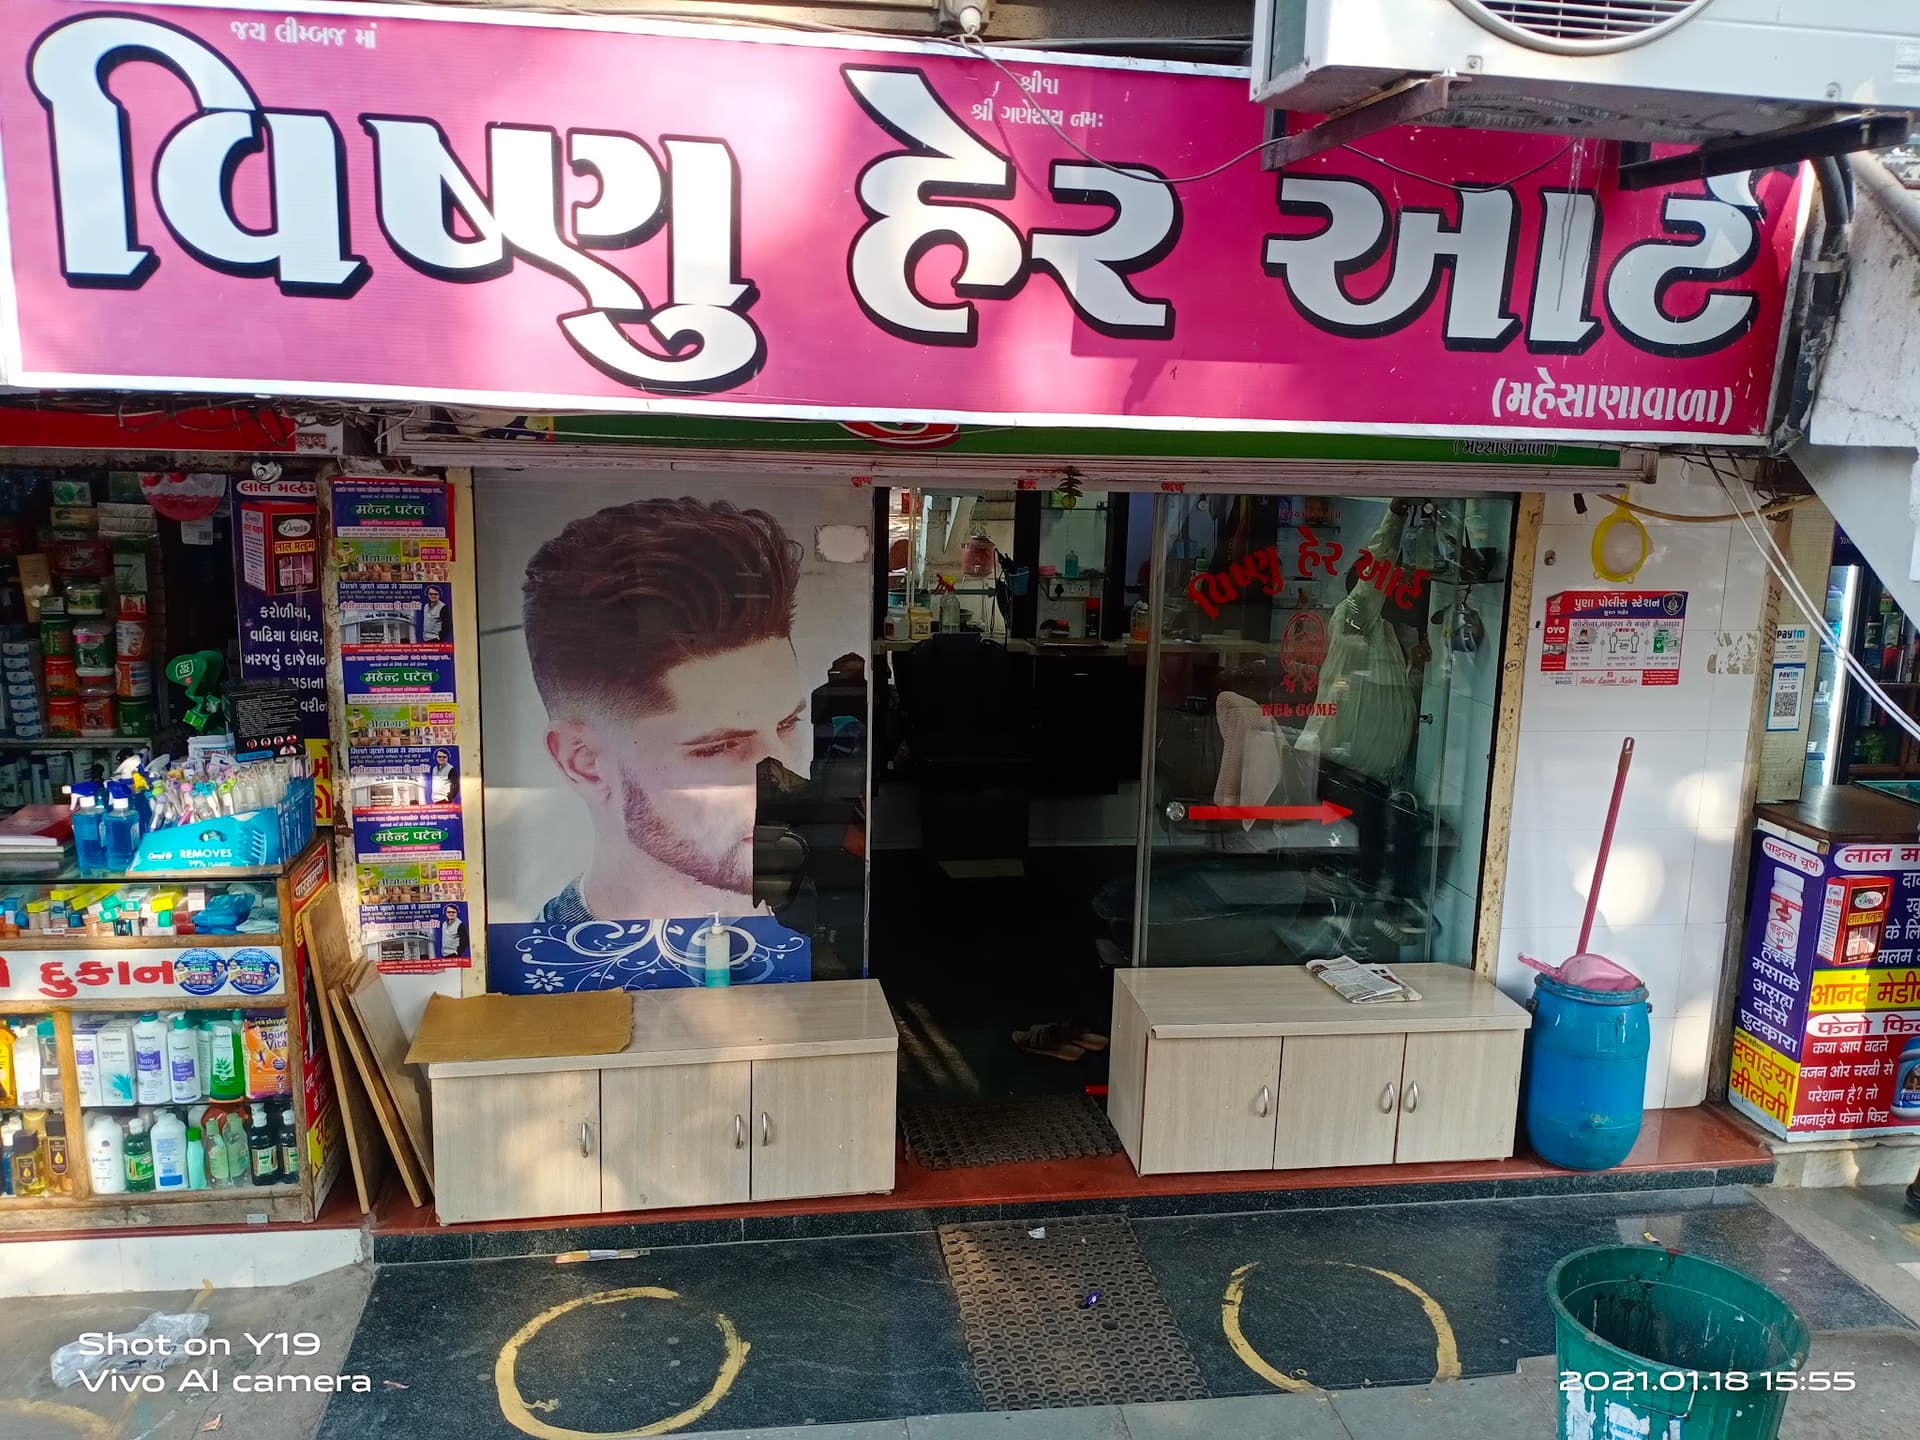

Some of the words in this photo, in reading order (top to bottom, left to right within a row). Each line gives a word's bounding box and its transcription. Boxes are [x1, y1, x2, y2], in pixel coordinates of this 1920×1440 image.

[230, 21, 267, 41] જય
[354, 22, 378, 48] માં
[971, 98, 993, 121] શ્રી
[1000, 99, 1064, 126] ગણેશાય
[26, 11, 767, 395] વિષ્ણુ
[839, 63, 1185, 348] હેર
[1490, 366, 1734, 426] (મહેસાણાવાળા)
[240, 482, 272, 493] લાલ
[395, 503, 425, 515] पटेल
[1187, 546, 1285, 619] વિષ્ણુ
[1297, 526, 1344, 577] હેર
[1598, 596, 1627, 608] પોલીસ
[1631, 596, 1660, 608] સ્ટેશન
[1546, 626, 1566, 634] OYO
[365, 669, 400, 683] महेन्द्र
[403, 670, 433, 682] पटेल
[376, 829, 410, 843] महेन्द्र
[413, 829, 442, 842] पटेल
[179, 848, 233, 859] REMOVES
[1844, 848, 1892, 863] लाल
[1885, 918, 1901, 940] के
[1877, 949, 1914, 964] मलम
[38, 960, 175, 999] દુકાન
[1752, 956, 1801, 992] मसाके
[1811, 974, 1870, 1006] आनंद
[1741, 1008, 1798, 1053] छुटकारा
[1817, 1015, 1873, 1035] फेनो
[1840, 1041, 1861, 1054] आप
[1800, 1065, 1827, 1079] वजन
[1854, 1058, 1881, 1077] चरबी
[1883, 1059, 1894, 1075] से
[1808, 1085, 1843, 1103] परेशान
[1865, 1083, 1879, 1100] तो
[1839, 1106, 1864, 1125] फेनो
[1866, 1106, 1890, 1123] फिट
